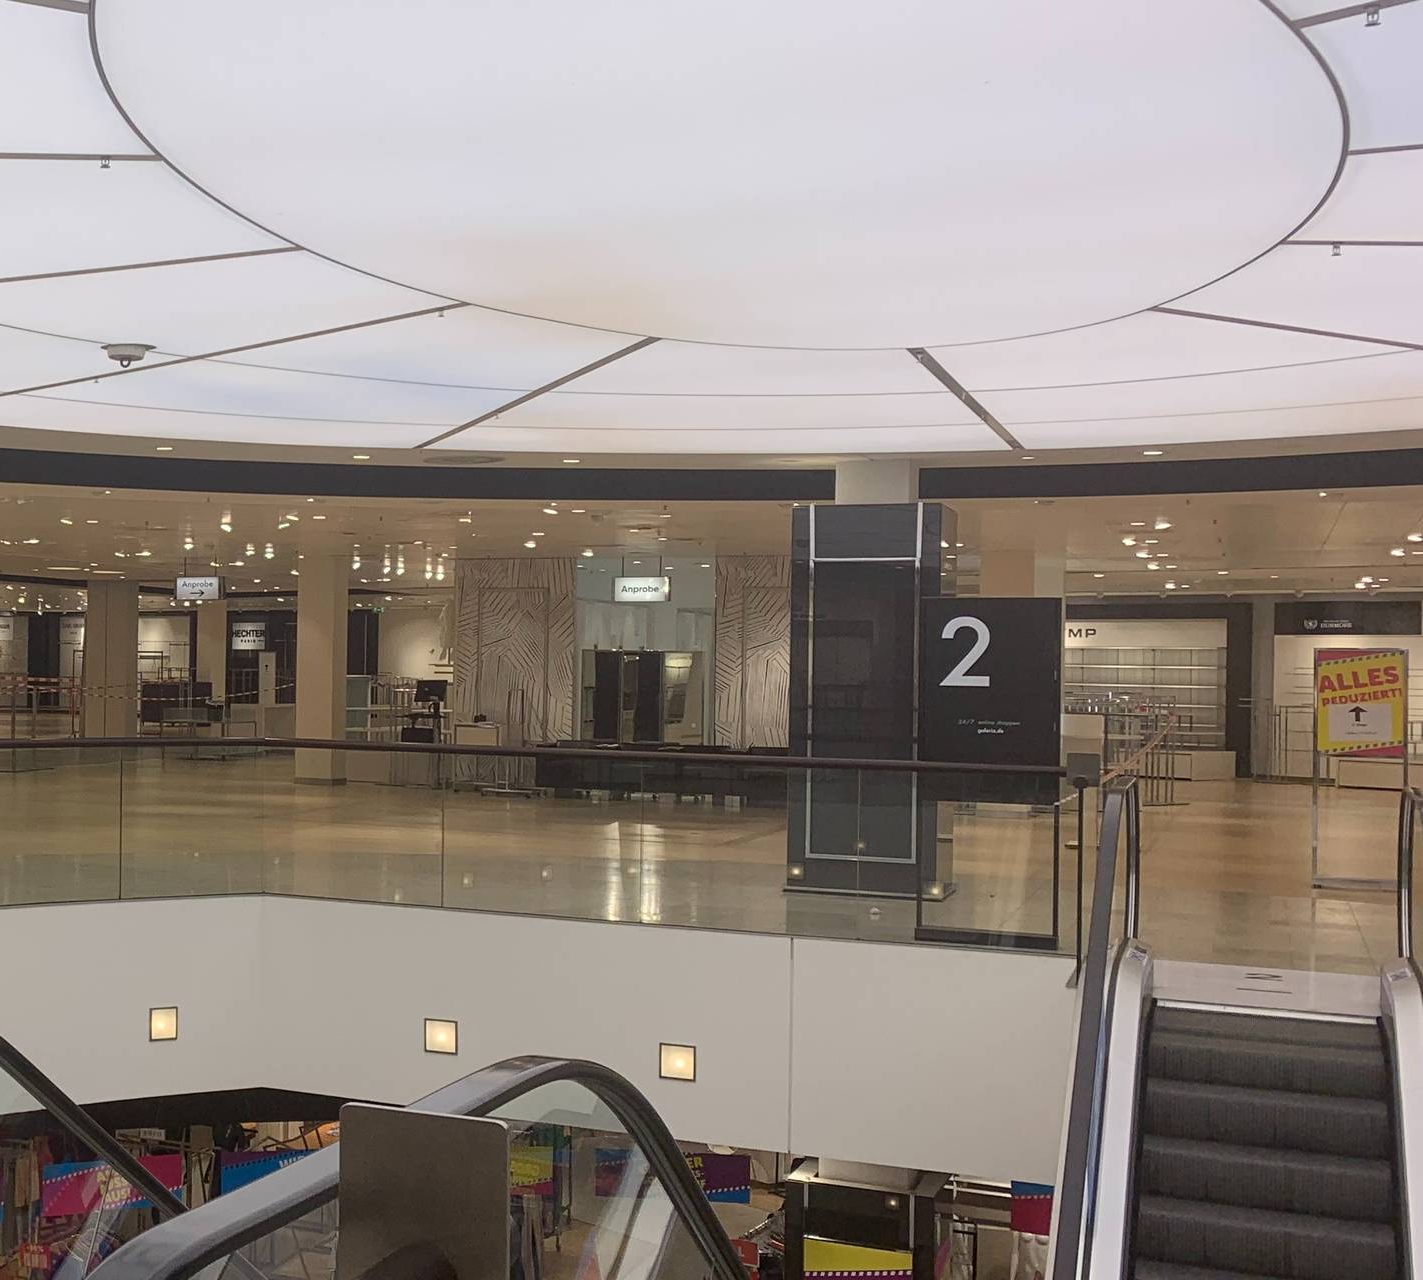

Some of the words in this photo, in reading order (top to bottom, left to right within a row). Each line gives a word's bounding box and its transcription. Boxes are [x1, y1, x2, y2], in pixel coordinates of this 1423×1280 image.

[181, 580, 214, 589] Anprobe
[621, 585, 660, 594] Anprobe
[939, 615, 991, 687] 2
[1319, 665, 1400, 693] ALLES
[1321, 687, 1402, 707] REDUZIERT!
